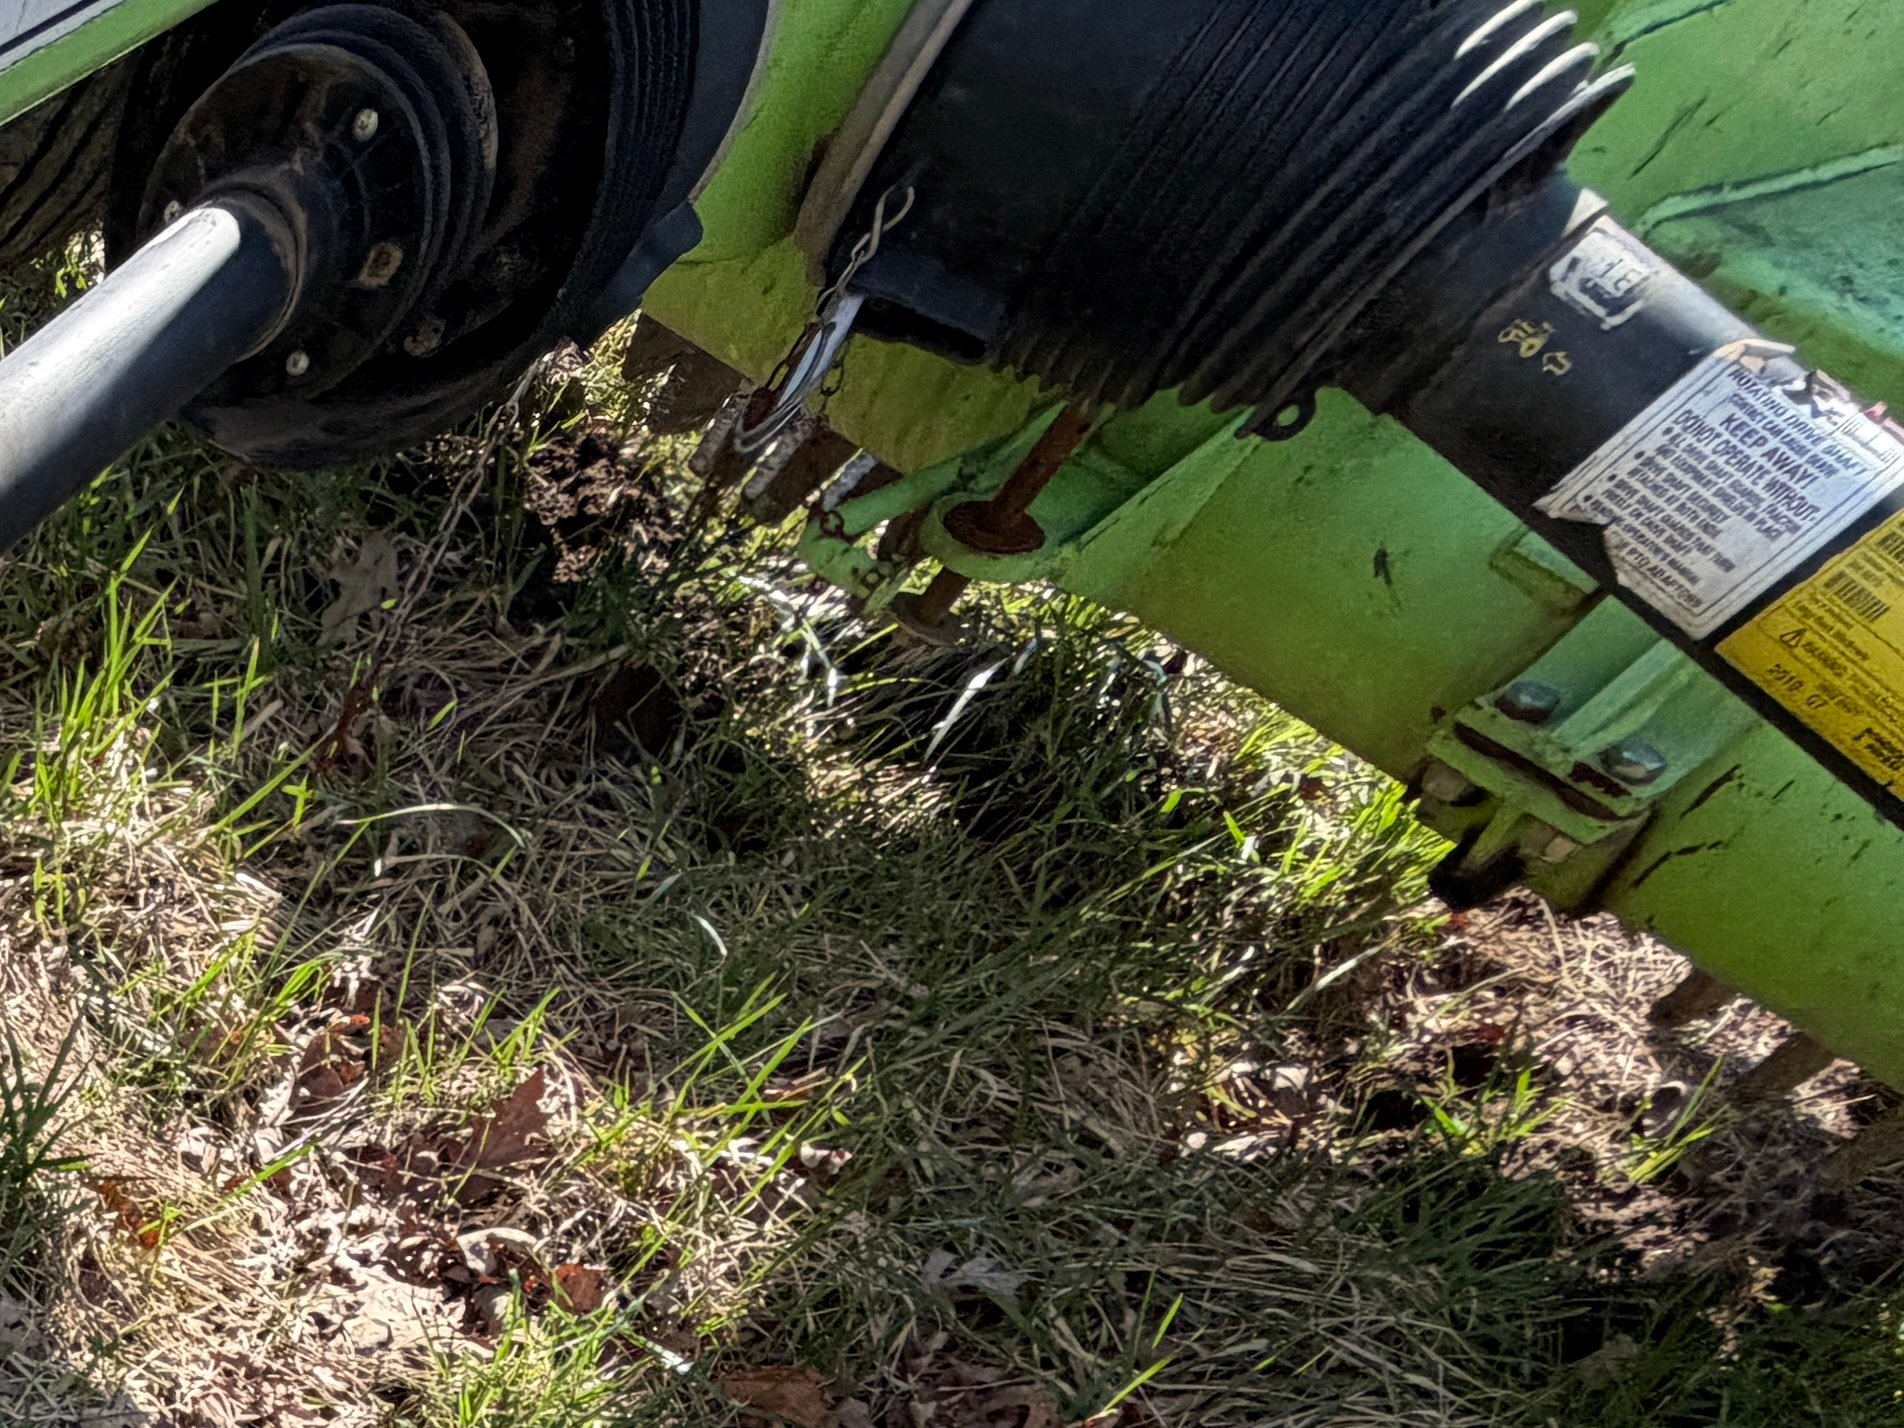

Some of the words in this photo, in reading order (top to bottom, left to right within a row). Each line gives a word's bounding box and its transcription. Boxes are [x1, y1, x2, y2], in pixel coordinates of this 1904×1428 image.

[1688, 421, 1722, 447] NOT
[1710, 438, 1772, 484] OPERATE
[1719, 414, 1769, 451] KEEP
[1760, 445, 1819, 489] AWAY!
